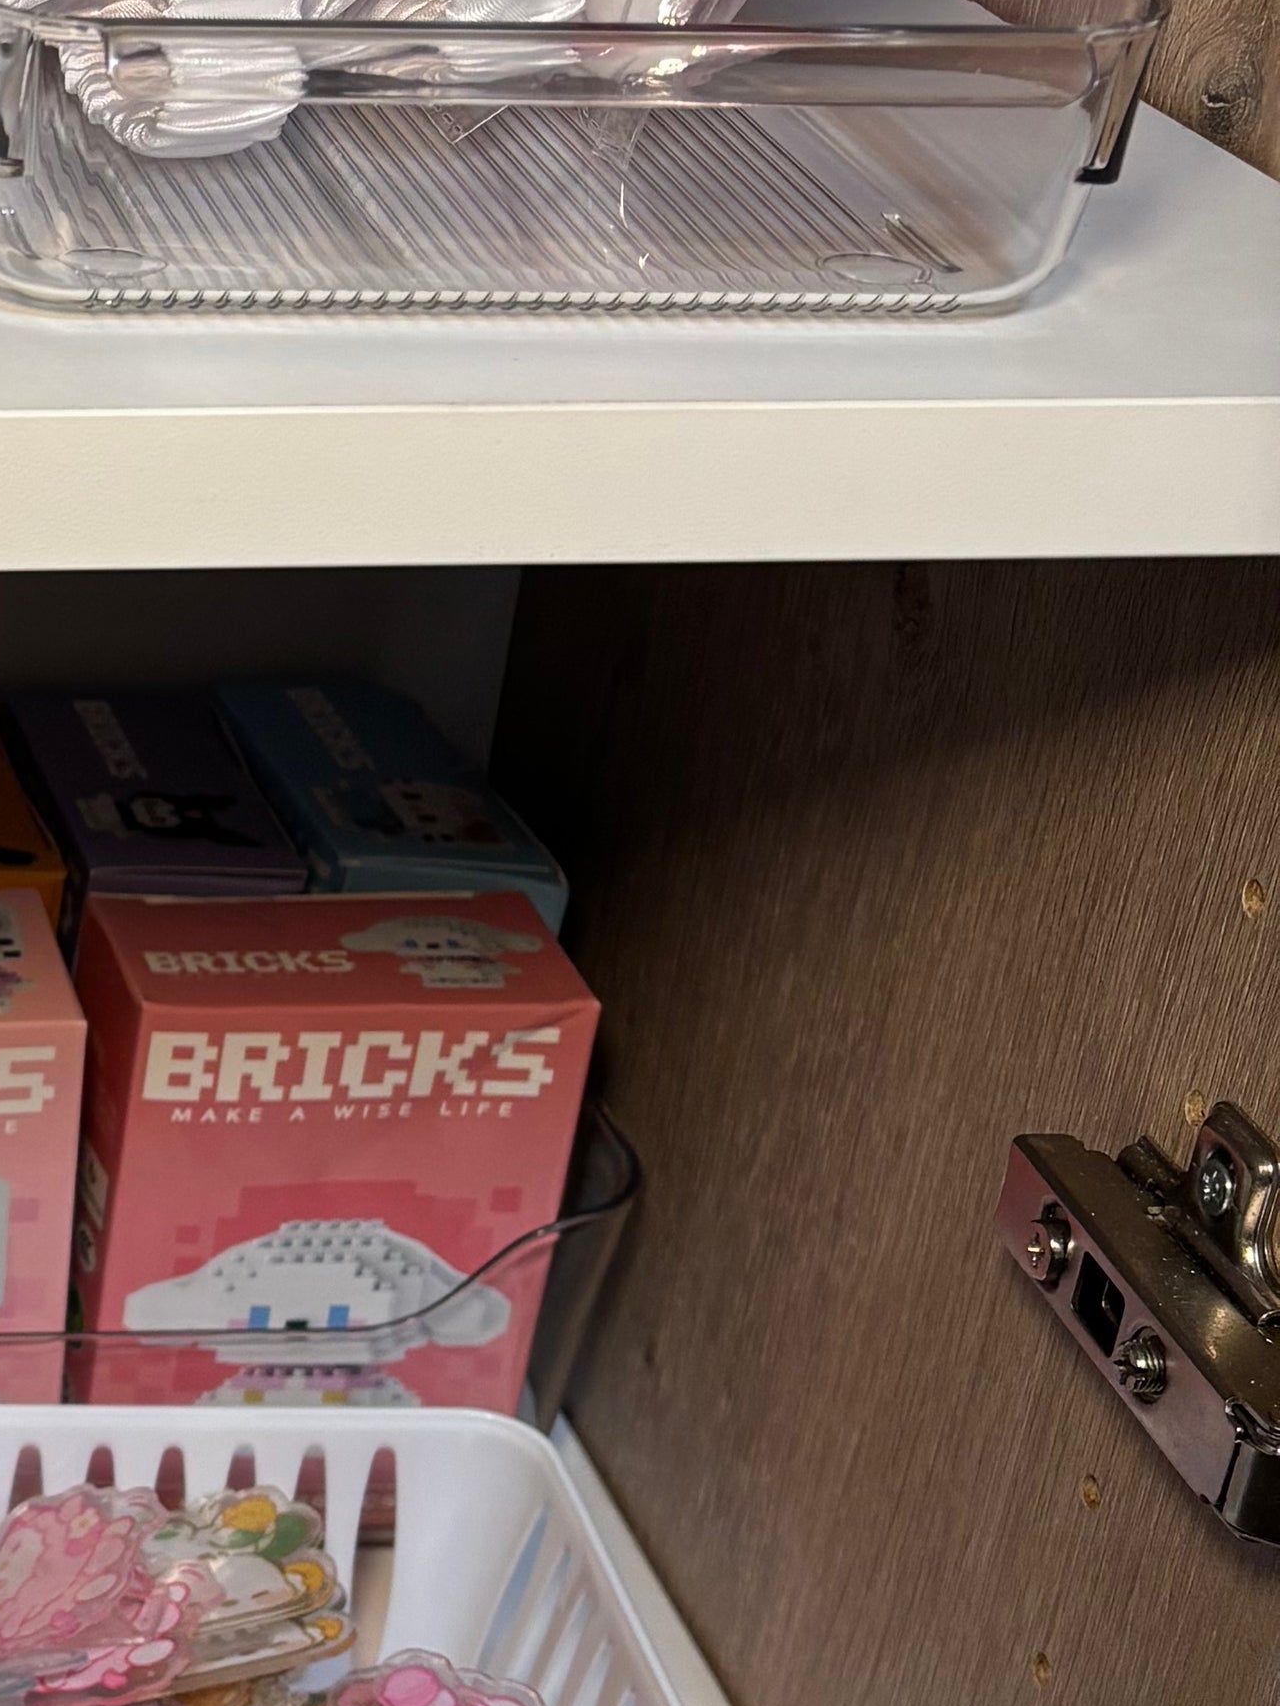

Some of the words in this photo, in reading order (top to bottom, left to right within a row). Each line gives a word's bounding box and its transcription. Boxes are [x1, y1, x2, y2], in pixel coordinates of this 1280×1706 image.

[142, 950, 356, 975] BRICKS
[142, 1026, 561, 1102] BRICKS
[170, 1106, 264, 1124] MAKE
[289, 1106, 306, 1122] A
[334, 1102, 413, 1120] WISE
[439, 1100, 515, 1118] LIFE
